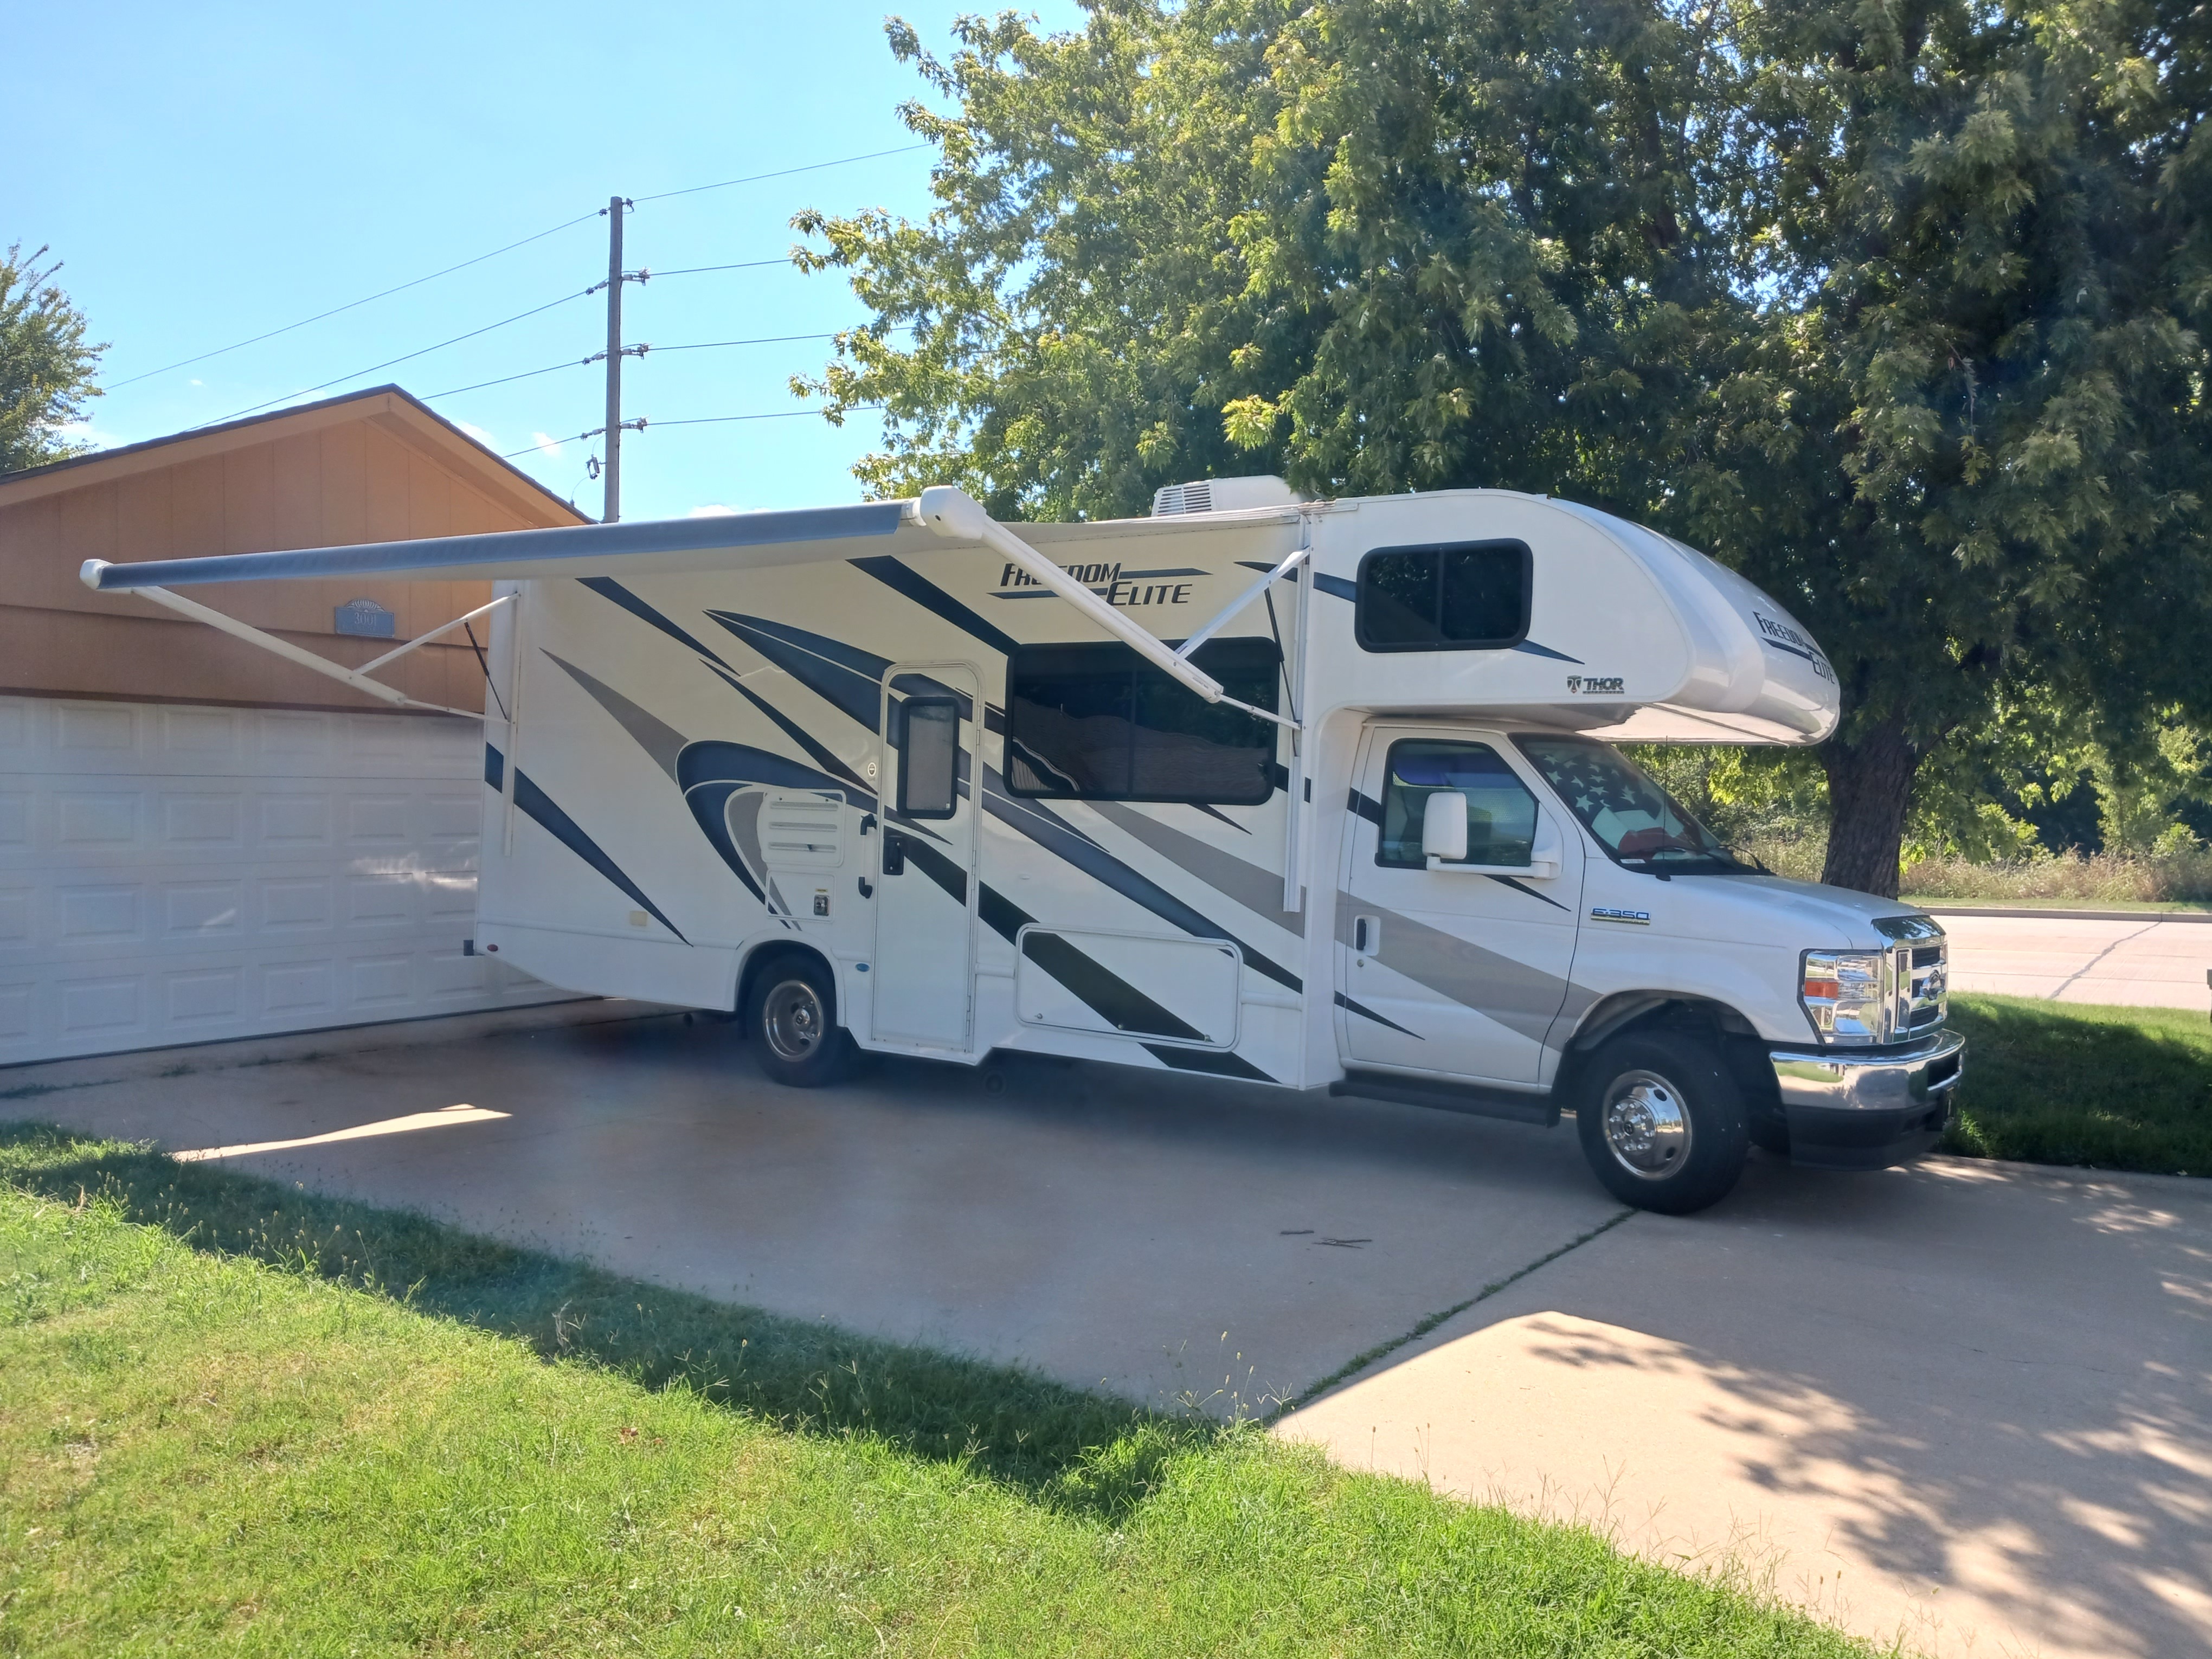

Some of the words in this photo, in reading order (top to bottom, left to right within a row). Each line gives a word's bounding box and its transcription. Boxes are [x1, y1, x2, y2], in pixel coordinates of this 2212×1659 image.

[1000, 562, 1122, 587] FRDOM
[1106, 581, 1193, 606] ELITE
[354, 612, 376, 626] 3001
[1583, 677, 1624, 691] THOR
